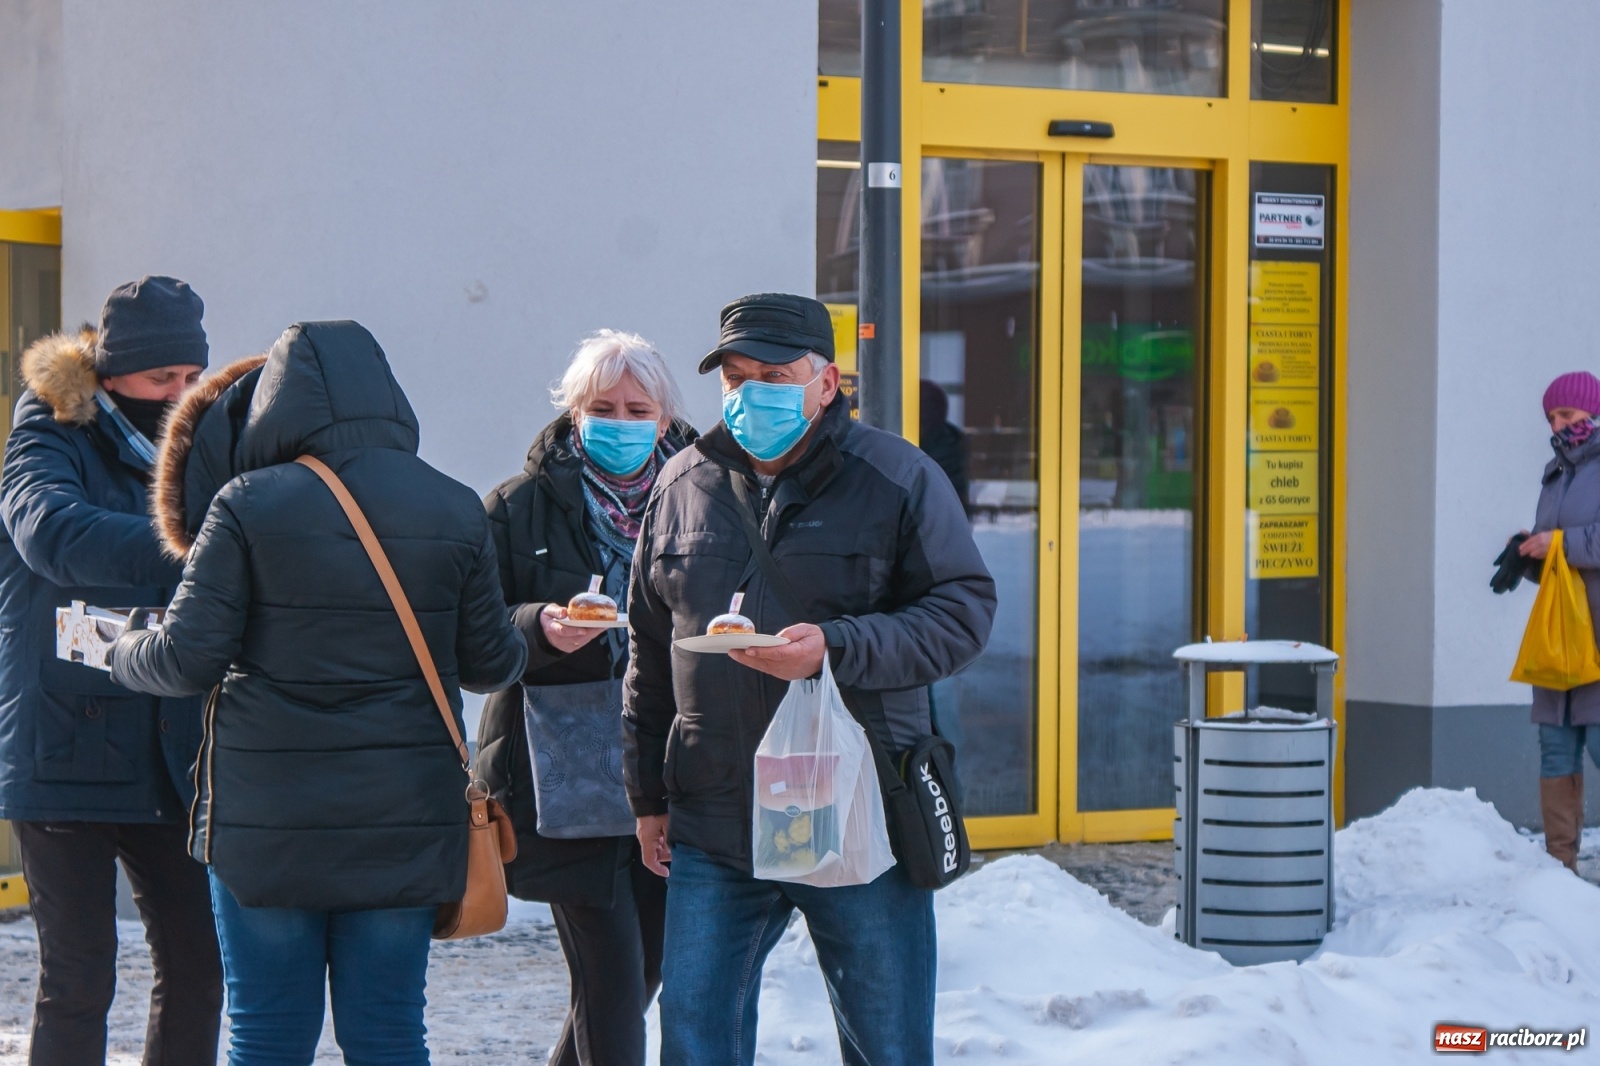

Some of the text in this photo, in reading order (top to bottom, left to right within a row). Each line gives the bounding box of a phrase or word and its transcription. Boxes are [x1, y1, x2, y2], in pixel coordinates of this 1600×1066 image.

[888, 168, 896, 181] 6
[1259, 212, 1302, 224] PARTNER
[1256, 330, 1283, 338] CIASTA
[1289, 330, 1313, 339] TORTY
[1255, 434, 1282, 443] CIASTA
[1288, 434, 1313, 443] TORTY
[1266, 459, 1304, 471] Tu kupisz
[1270, 475, 1300, 489] chleb
[1265, 495, 1277, 505] GS
[1278, 494, 1311, 506] Gorzyce
[1259, 521, 1309, 529] ZAPRASZAMY
[1263, 540, 1304, 553] ŚWIEŻE
[1255, 558, 1314, 569] PIECZYWO
[920, 762, 958, 874] Reebok
